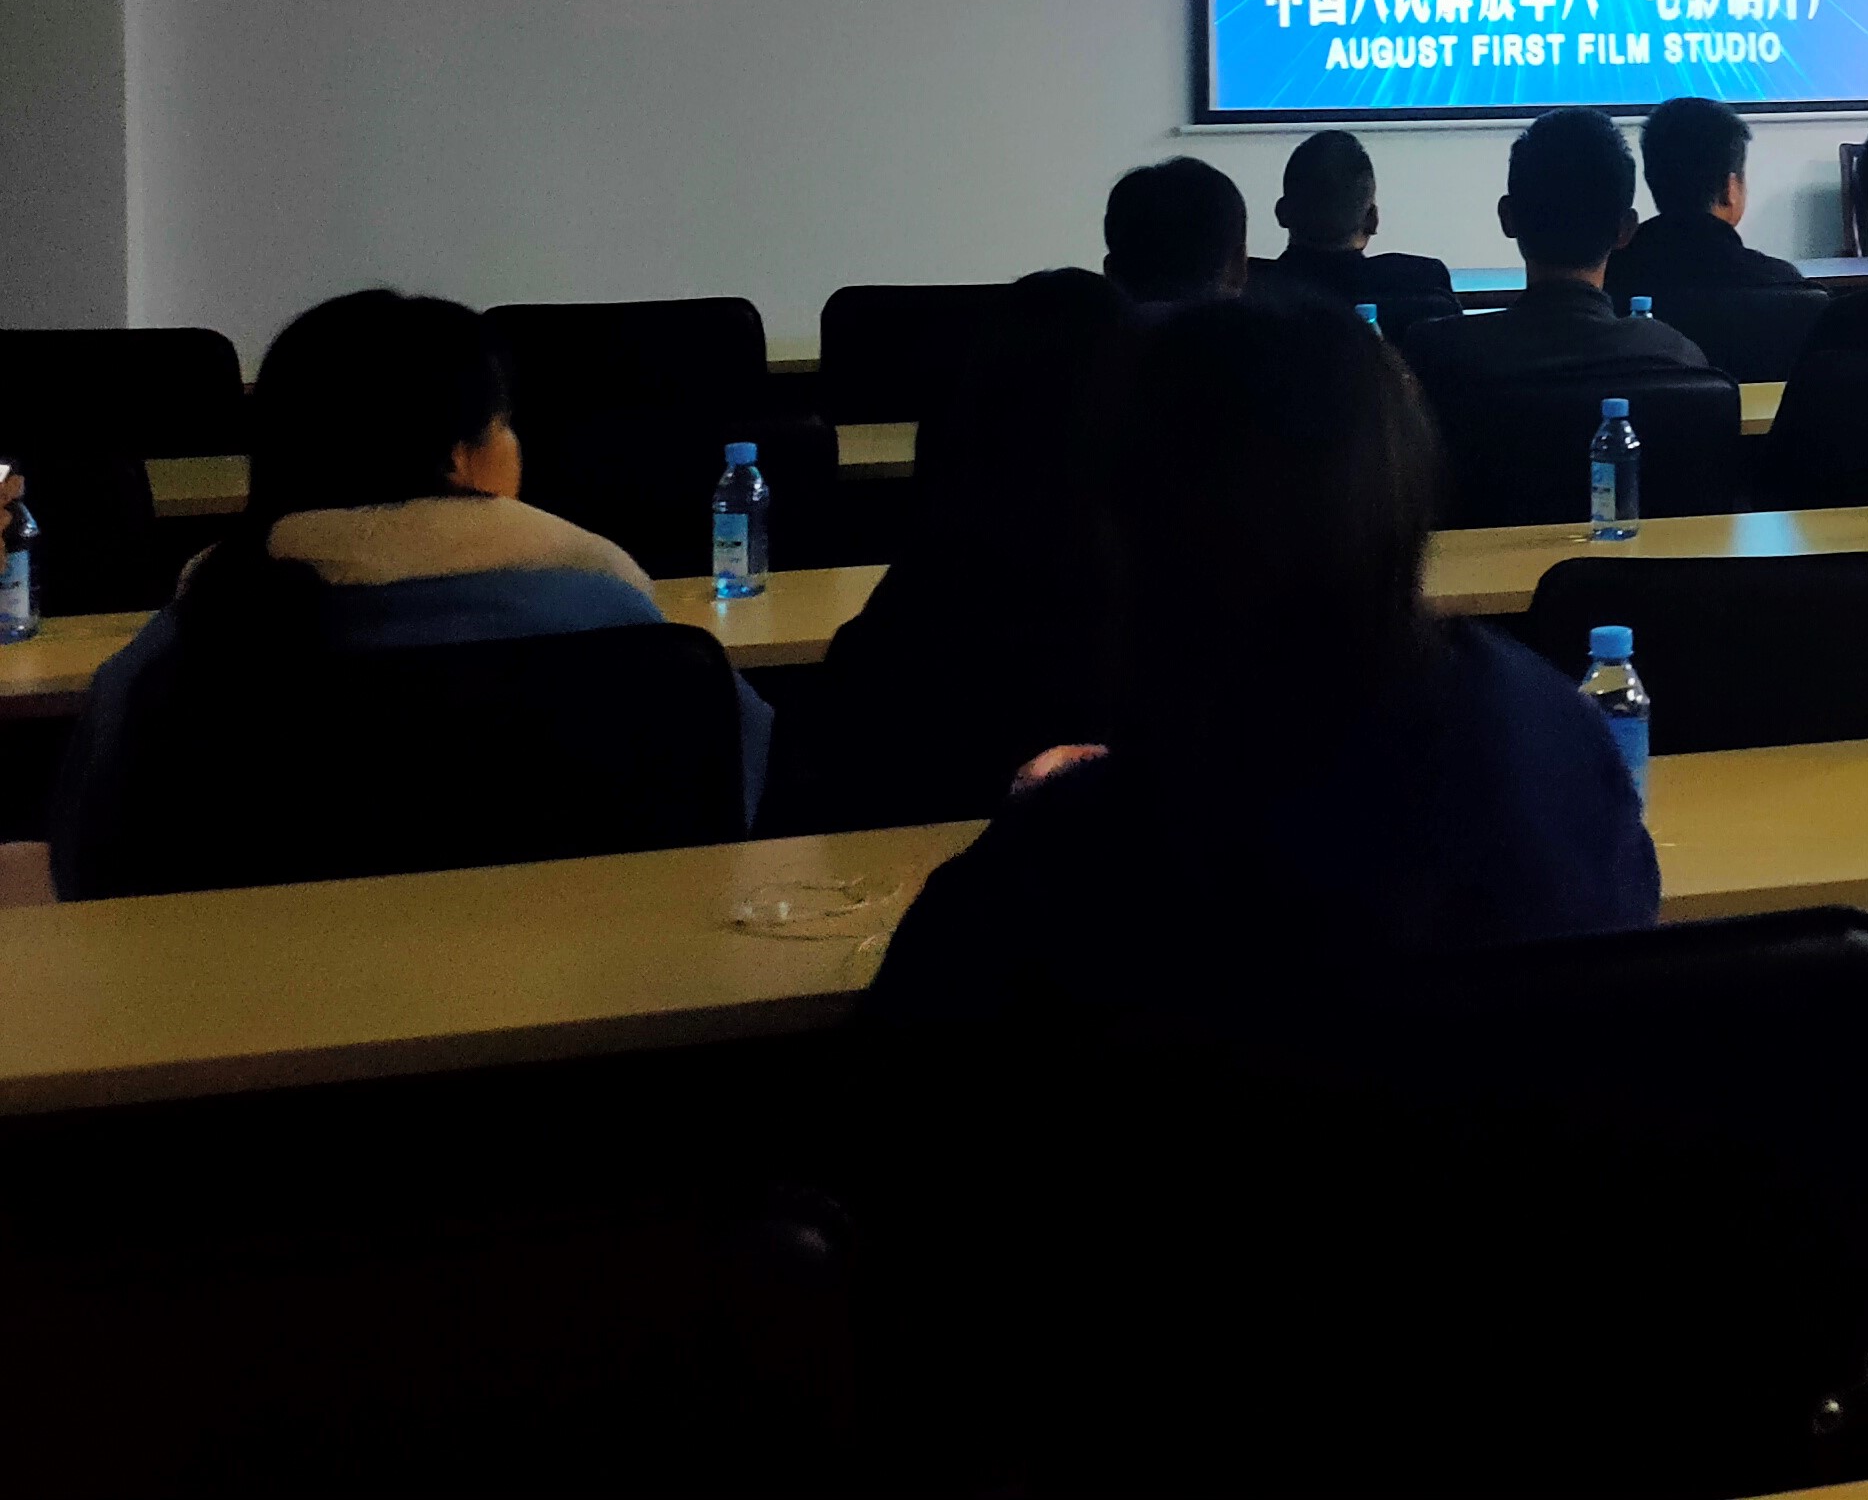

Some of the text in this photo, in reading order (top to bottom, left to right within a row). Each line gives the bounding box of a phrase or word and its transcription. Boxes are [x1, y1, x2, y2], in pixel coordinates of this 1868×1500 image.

[1325, 31, 1781, 70] AUGUST FIRST FILM STUDIO
